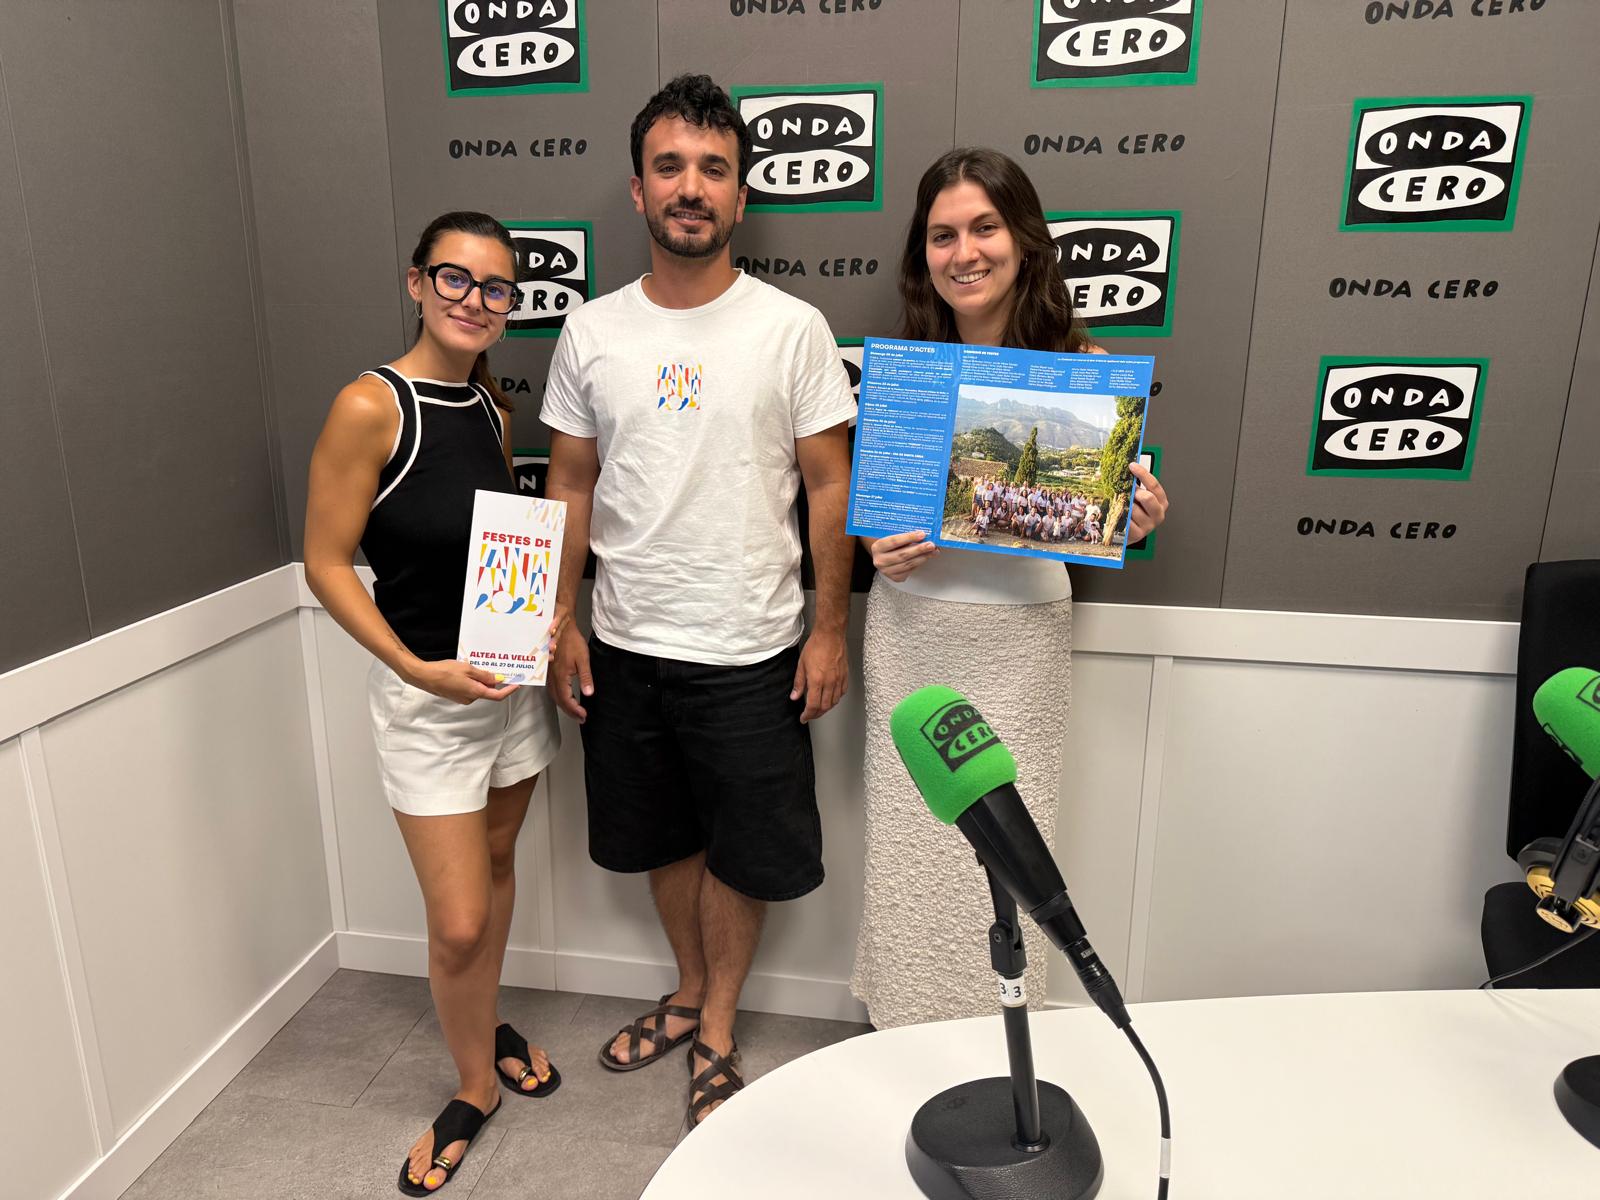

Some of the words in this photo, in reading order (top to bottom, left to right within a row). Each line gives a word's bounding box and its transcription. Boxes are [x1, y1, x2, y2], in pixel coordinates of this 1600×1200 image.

[465, 0, 557, 24] ONDA
[730, 0, 805, 16] ONDA
[1365, 1, 1454, 24] ONDA
[1066, 28, 1168, 57] CERO
[472, 41, 559, 68] CERO
[757, 116, 854, 140] ONDA
[449, 139, 518, 159] ONDA
[529, 138, 588, 157] CERO
[1024, 134, 1103, 155] ONDA
[1117, 133, 1186, 154] CERO
[1378, 130, 1492, 155] ONDA
[762, 159, 854, 185] CERO
[1378, 175, 1487, 202] CERO
[818, 258, 879, 277] CERO
[1072, 284, 1144, 309] ERO
[1328, 277, 1412, 299] ONDA
[1427, 278, 1499, 299] CERO
[870, 343, 908, 351] PROGRAMA
[909, 346, 936, 354] D'ACTES
[1343, 386, 1450, 408] ONDA
[1343, 428, 1446, 452] CERO
[482, 531, 531, 546] FESTES
[534, 537, 552, 549] DE
[1297, 517, 1376, 537] ONDA
[1390, 521, 1457, 540] CERO
[469, 651, 497, 659] ALTEA
[498, 653, 509, 661] LA
[511, 654, 537, 662] VELLA
[1013, 985, 1022, 998] 3
